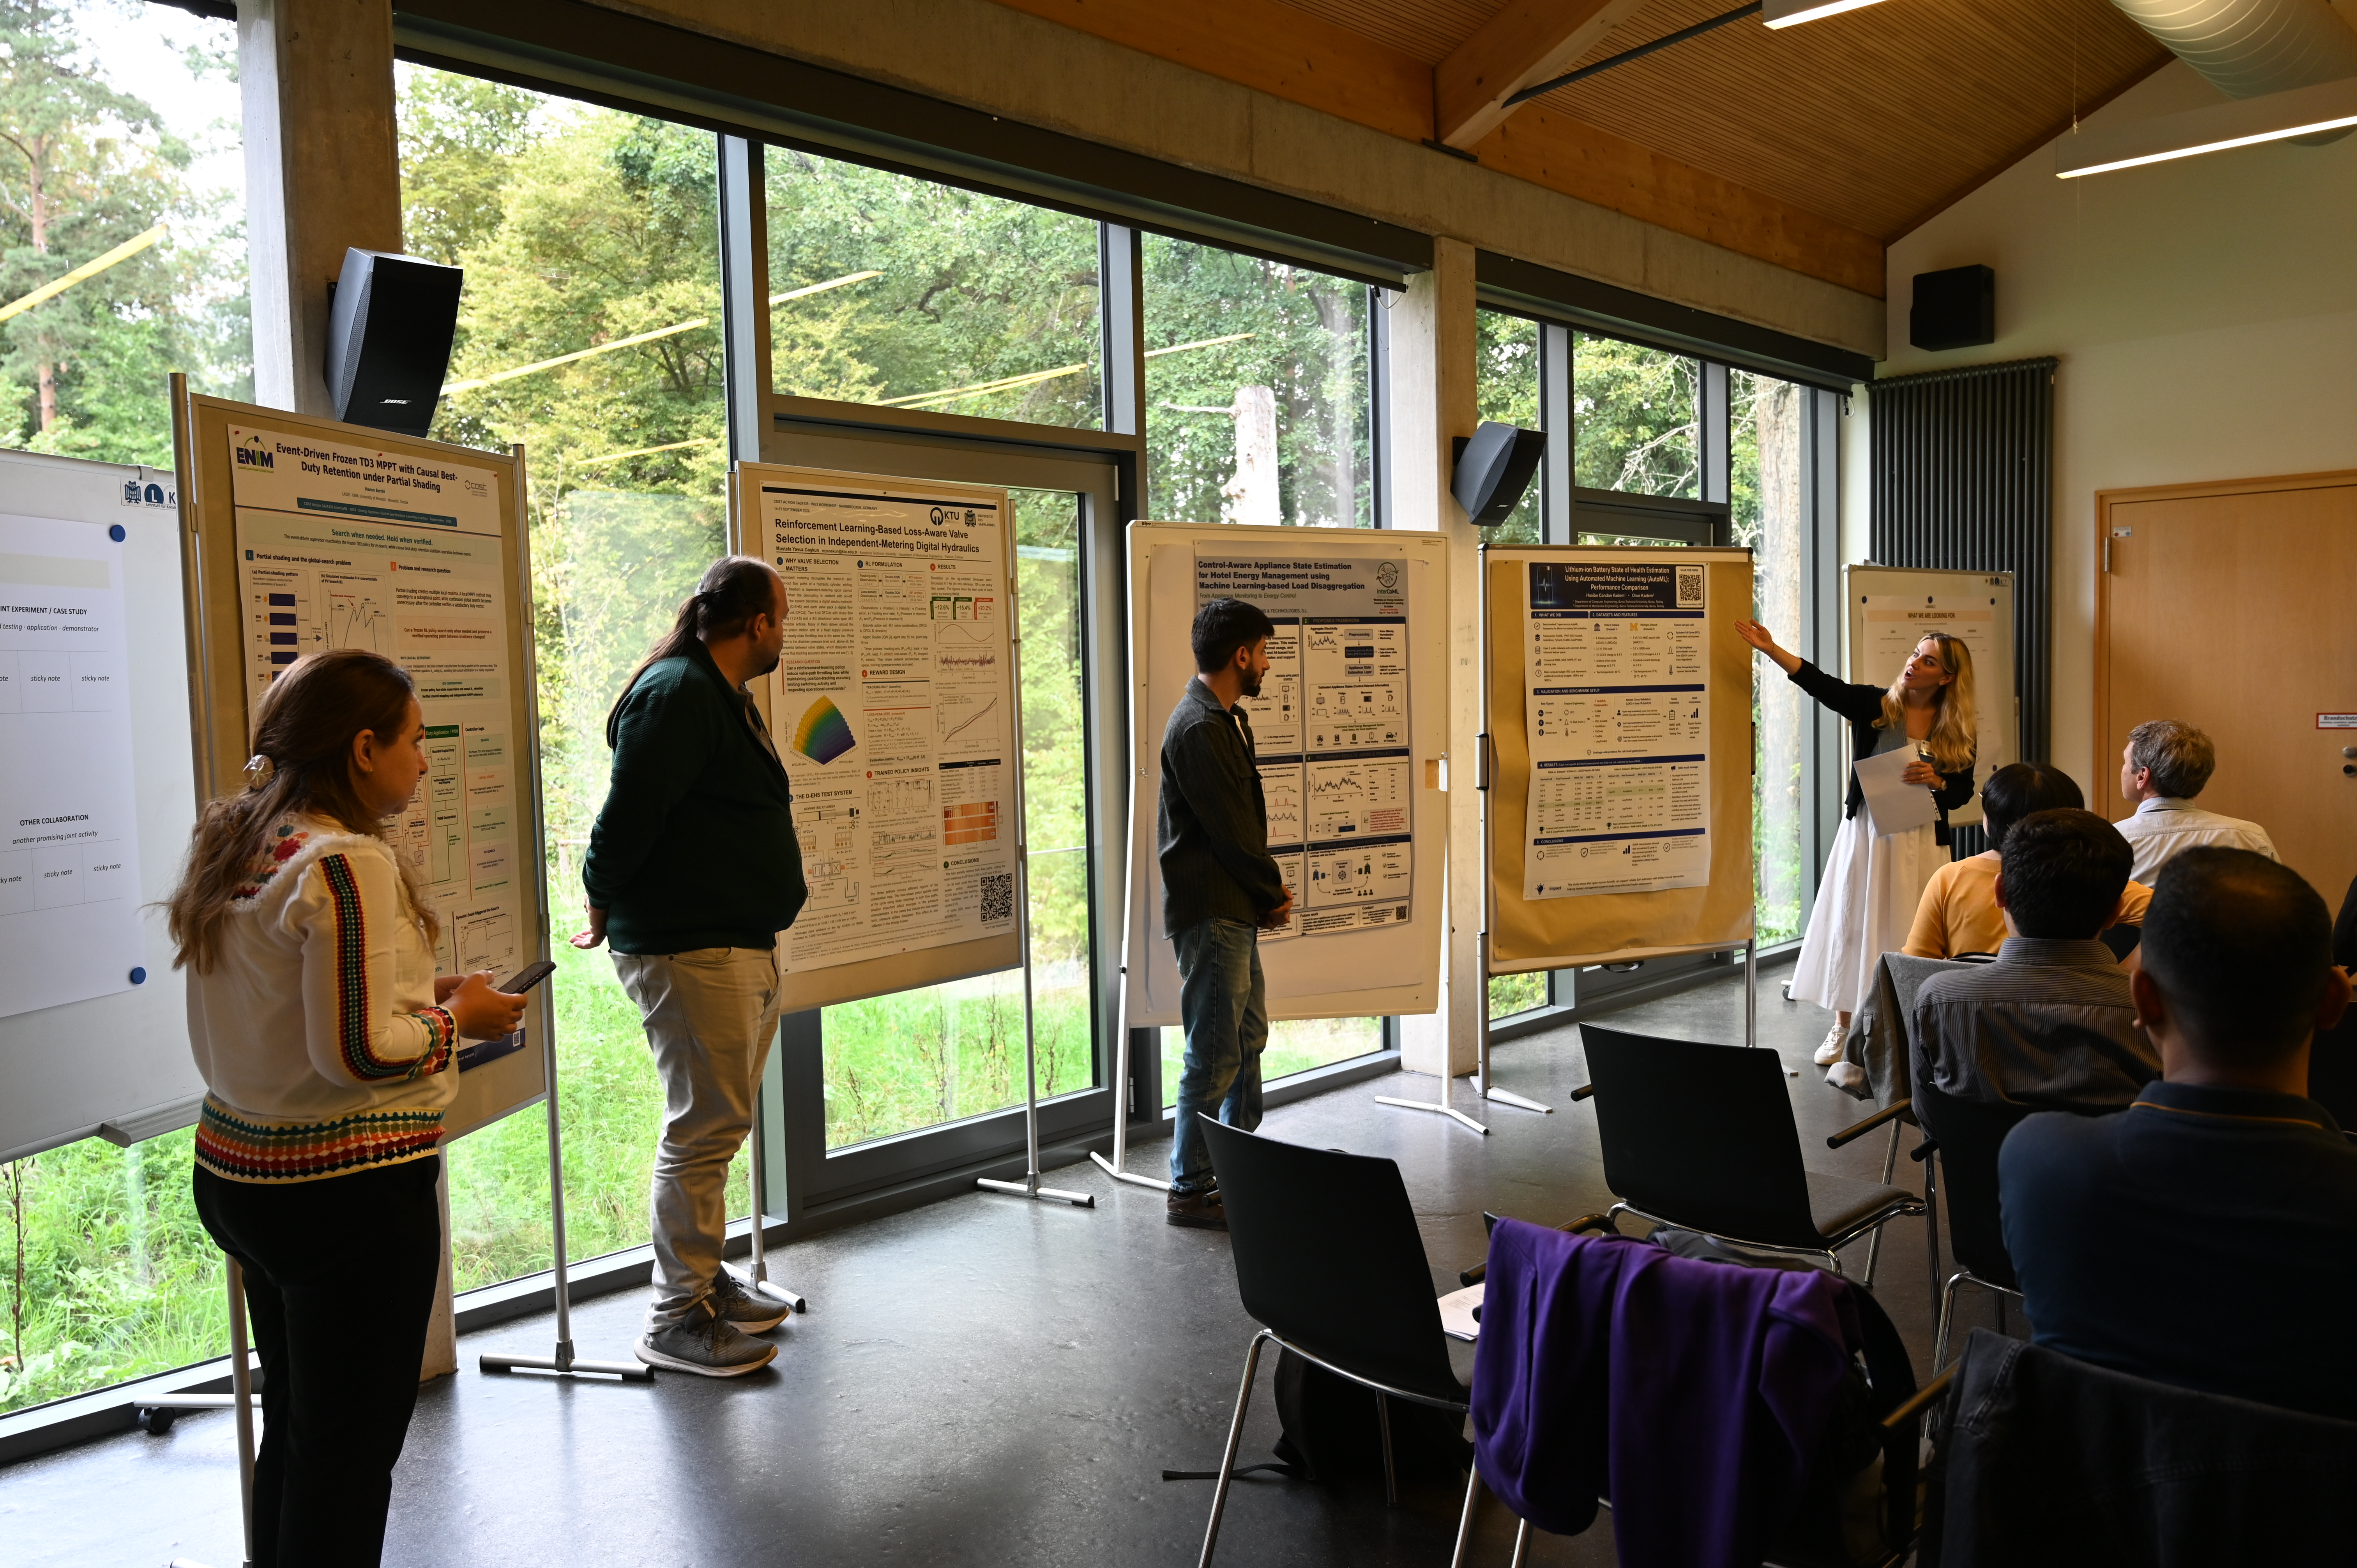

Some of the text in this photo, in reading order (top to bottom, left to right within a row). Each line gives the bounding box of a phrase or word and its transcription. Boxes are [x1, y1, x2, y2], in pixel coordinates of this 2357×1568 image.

[236, 447, 274, 468] ENIM
[276, 443, 458, 480] Event-Driven Frozen TD3 MPPT with Causal Best-
[301, 461, 440, 493] Duty Retention under Partial Shading
[471, 482, 487, 491] cost
[168, 491, 176, 504] K
[944, 510, 959, 521] KTU
[775, 519, 968, 539] Reinforcement Learning-Based Loss-Aware Valve
[776, 533, 979, 553] Selection in Independent-Metering Digital Hydraulics
[1233, 572, 1260, 580] Energy
[1262, 572, 1308, 580] Management
[1310, 572, 1329, 581] using
[1232, 582, 1289, 590] Learning-based
[41, 814, 88, 823] COLLABORATION
[37, 834, 64, 843] promising
